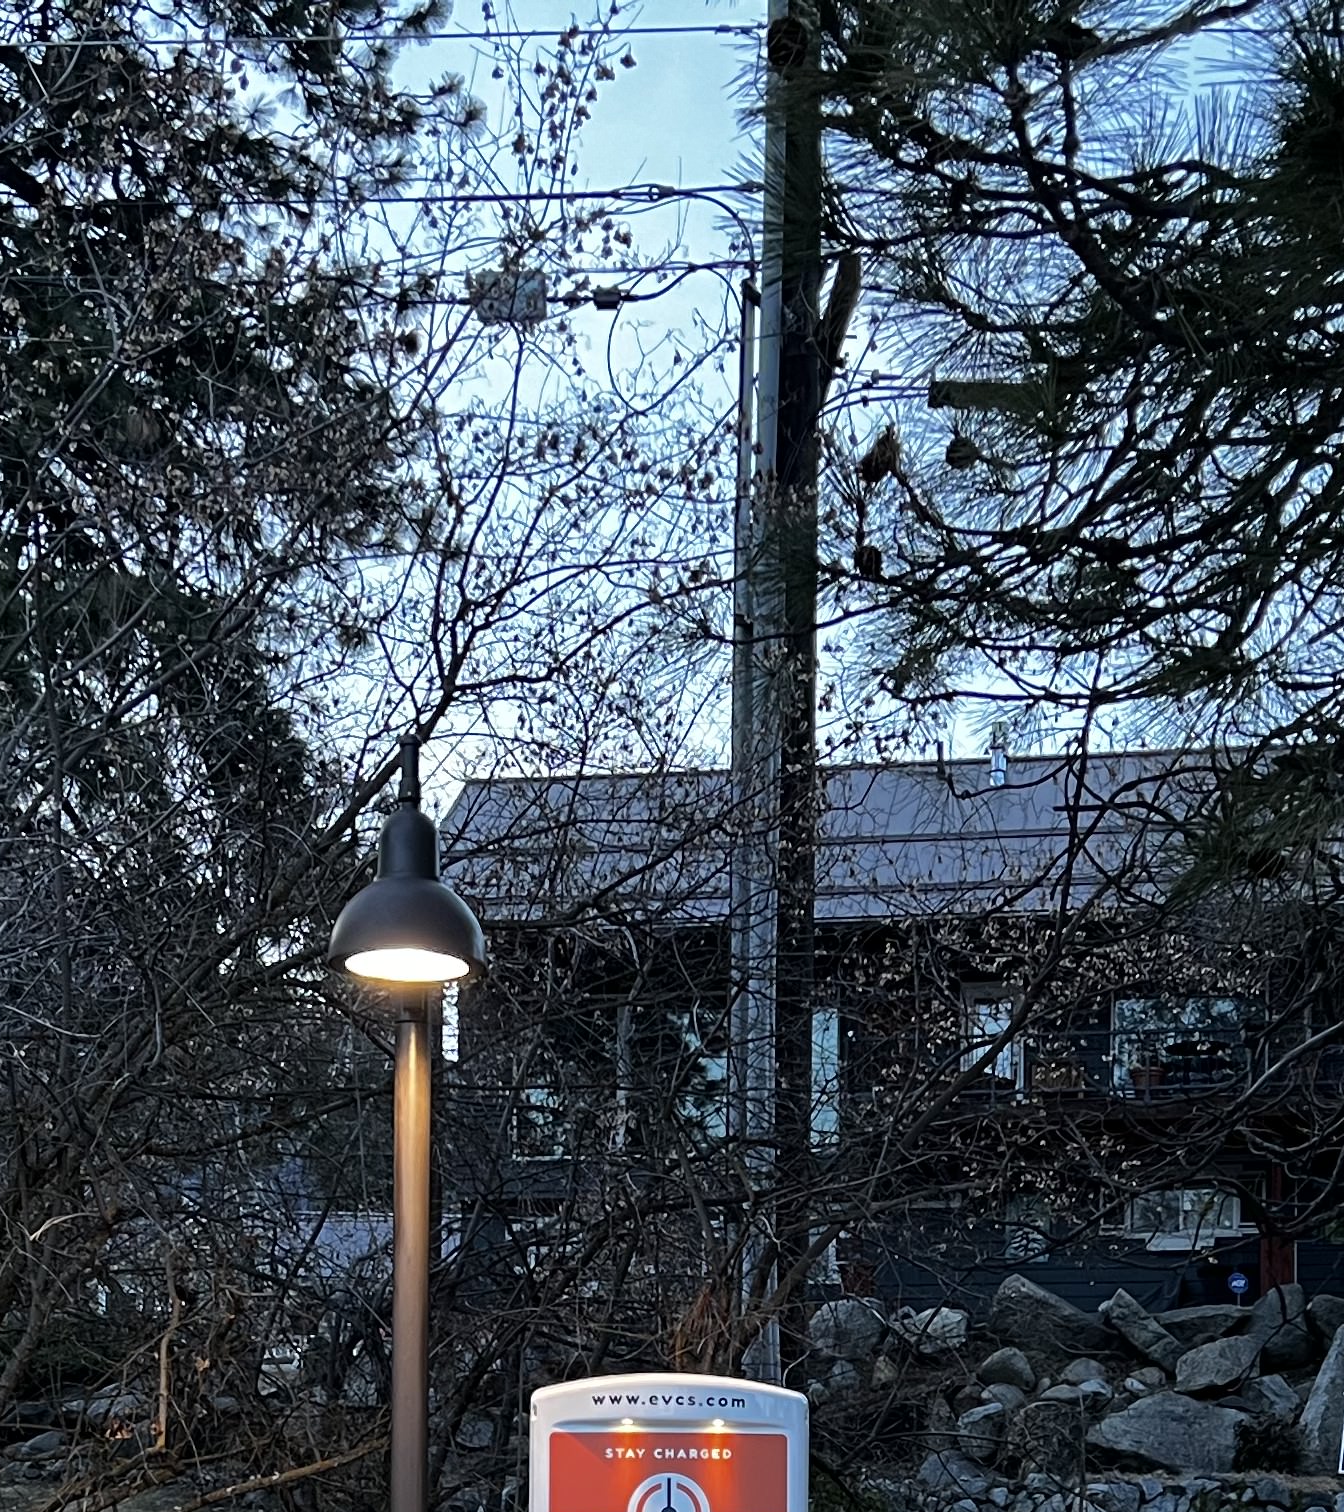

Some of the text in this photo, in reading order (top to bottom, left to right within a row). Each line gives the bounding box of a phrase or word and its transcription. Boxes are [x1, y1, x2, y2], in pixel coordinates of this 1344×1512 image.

[591, 1394, 746, 1409] www.evcs.com
[605, 1447, 733, 1460] STAY CHARGED
